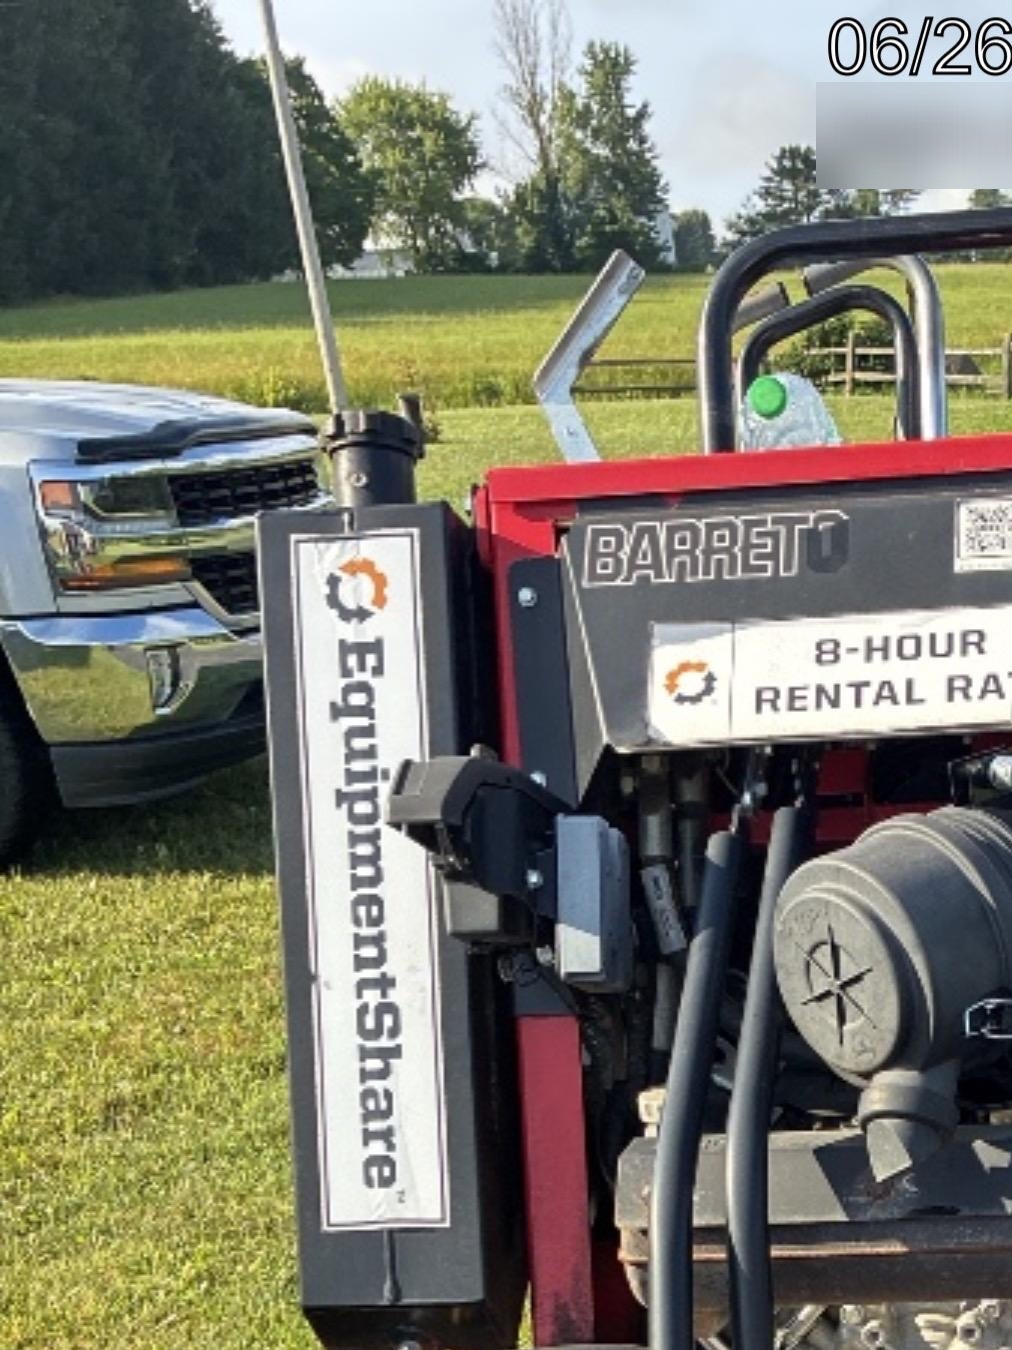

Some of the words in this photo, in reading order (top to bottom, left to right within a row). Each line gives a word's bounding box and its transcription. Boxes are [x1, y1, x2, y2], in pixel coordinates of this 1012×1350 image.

[581, 510, 850, 587] BARRETO
[815, 629, 986, 665] 8-HOUR
[755, 678, 925, 714] RENTAL
[329, 637, 403, 1189] EquipmentShare
